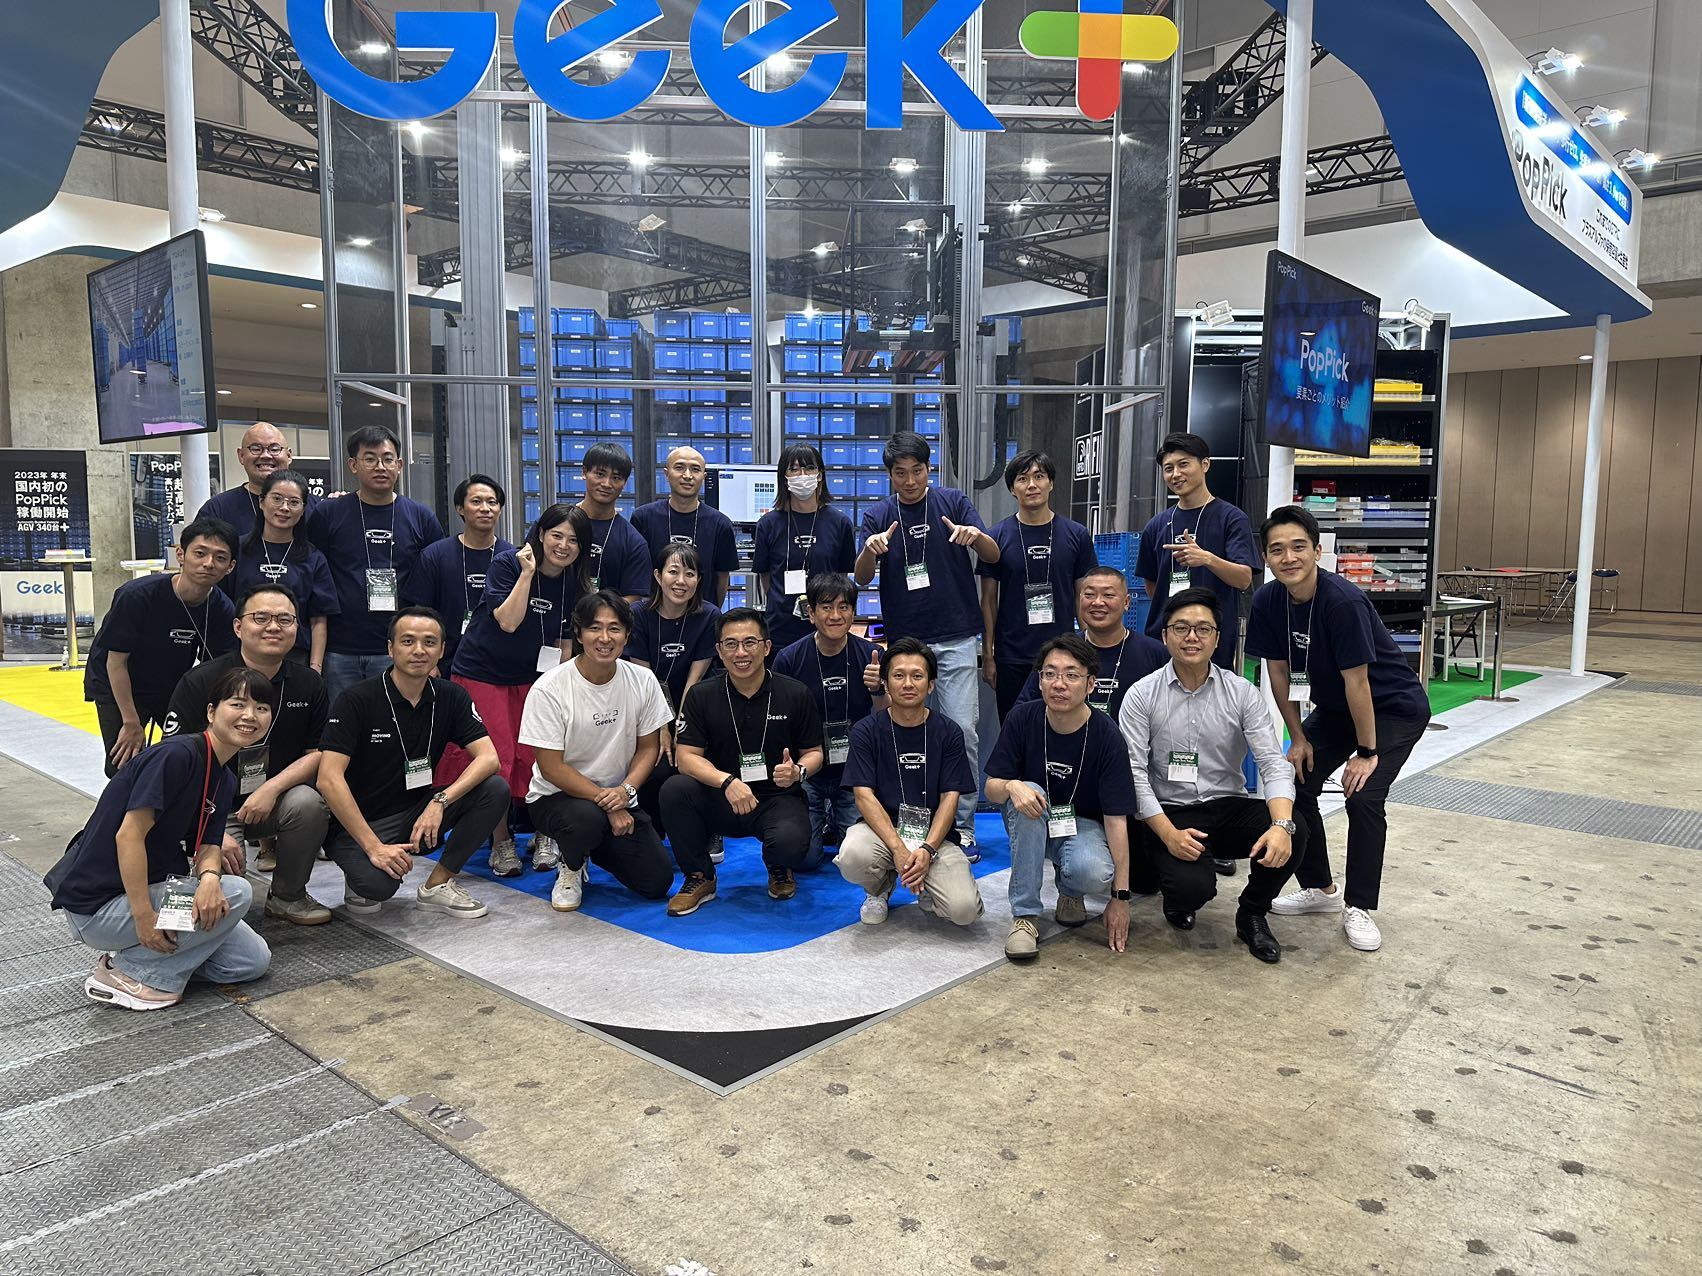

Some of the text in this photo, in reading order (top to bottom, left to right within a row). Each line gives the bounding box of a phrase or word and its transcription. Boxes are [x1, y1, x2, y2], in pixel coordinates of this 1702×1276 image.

[1512, 129, 1568, 219] PopPick
[1277, 261, 1297, 280] PopPick
[1300, 338, 1350, 383] PopPick
[14, 471, 67, 479] 2023年 年末
[15, 480, 68, 493] 国内初の
[15, 493, 68, 506] PopPick
[16, 506, 69, 519] 稼働開始
[17, 523, 34, 532] AGV
[17, 580, 64, 594] Geek
